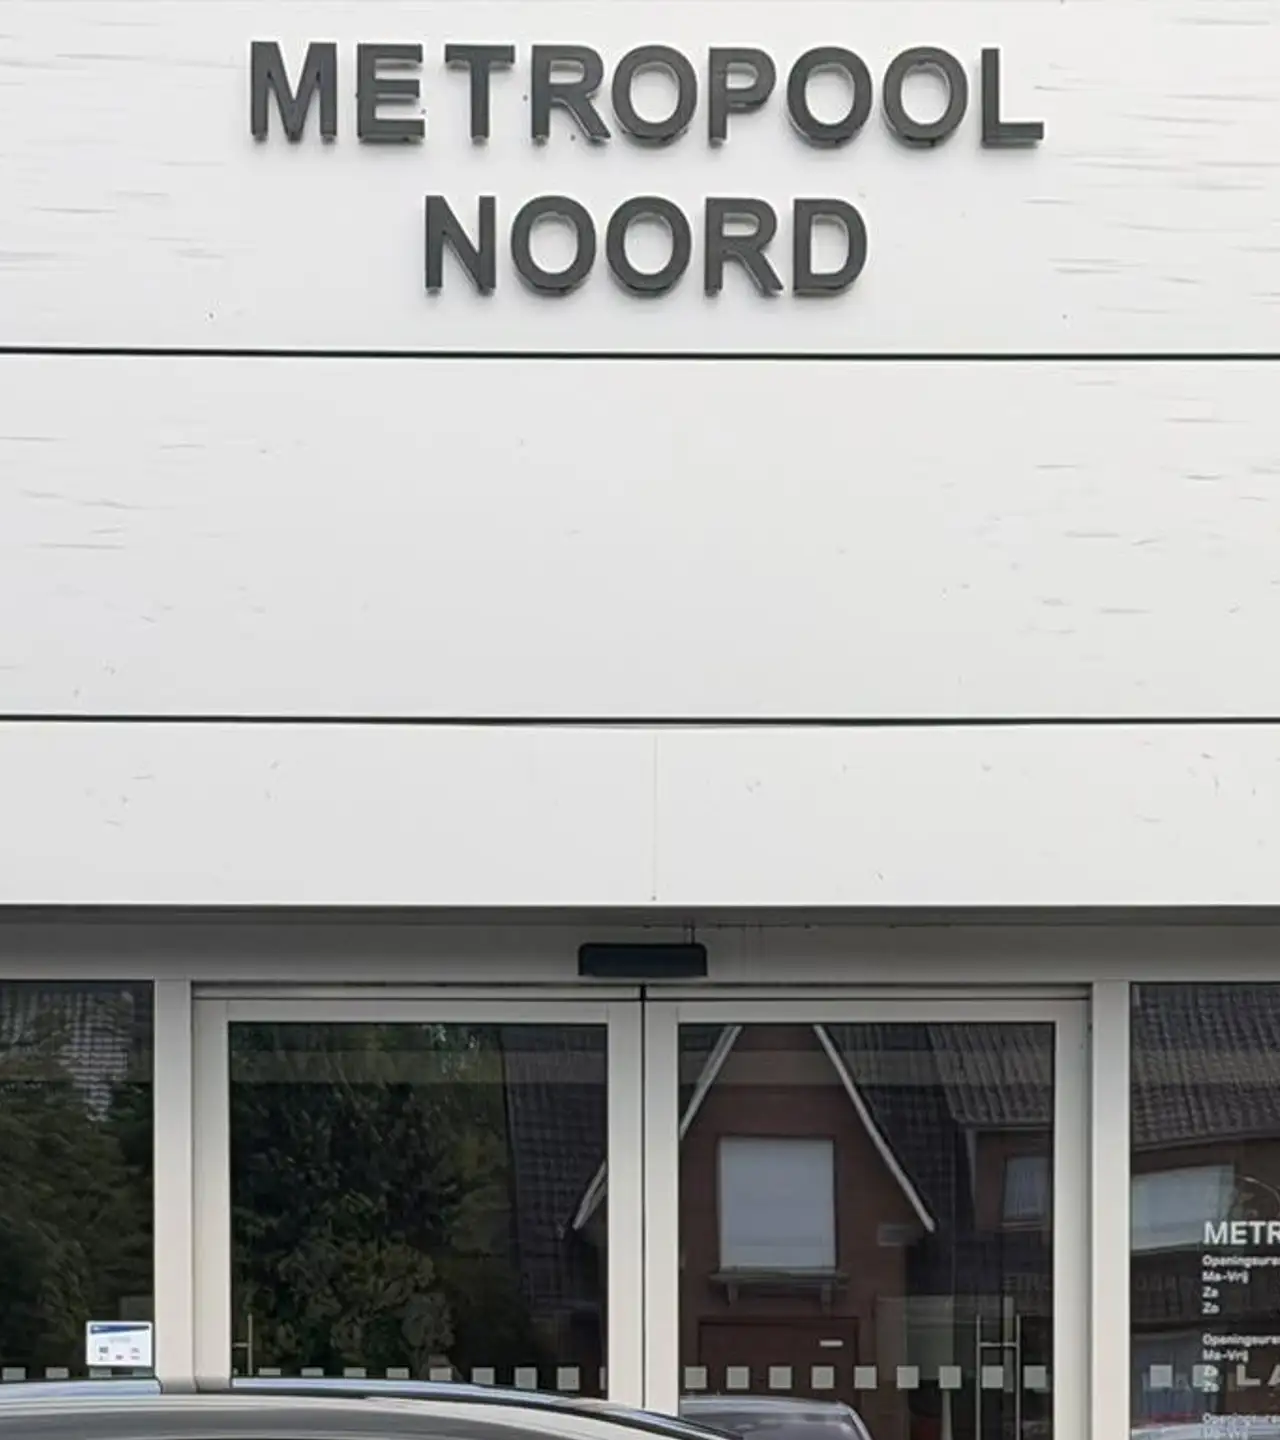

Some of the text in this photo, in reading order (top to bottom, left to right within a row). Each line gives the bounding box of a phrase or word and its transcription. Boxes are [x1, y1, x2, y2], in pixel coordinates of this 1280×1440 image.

[250, 41, 1045, 146] METROPOOL
[424, 196, 868, 297] NOORD
[1202, 1270, 1250, 1284] Ma-Vrij
[1202, 1286, 1219, 1299] Za
[1202, 1302, 1220, 1314] Zo
[1202, 1349, 1250, 1363] Ma-Vrij
